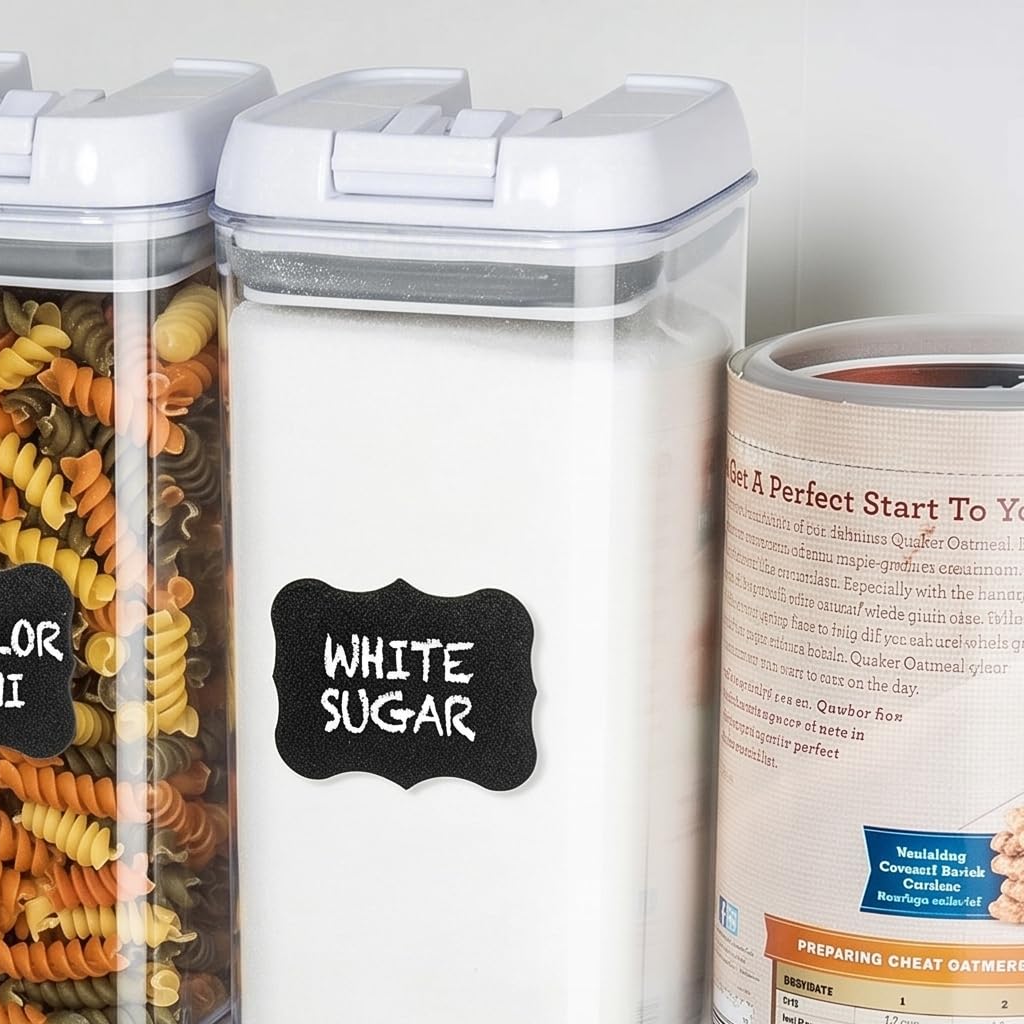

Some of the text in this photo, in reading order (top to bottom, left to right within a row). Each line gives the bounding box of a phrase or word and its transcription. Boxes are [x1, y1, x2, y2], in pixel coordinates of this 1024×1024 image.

[730, 458, 748, 489] Get
[752, 470, 764, 495] A
[770, 475, 854, 513] Perfect
[863, 491, 938, 520] Start
[949, 497, 986, 522] To
[324, 633, 474, 684] WHITE
[850, 650, 965, 674] Quaker Oatmeal
[867, 676, 889, 693] the
[892, 676, 920, 697] day.
[321, 688, 475, 742] SUGAR
[798, 939, 883, 966] PREPARING
[888, 956, 944, 972] CHEAT
[900, 997, 1009, 1010] 1 2
